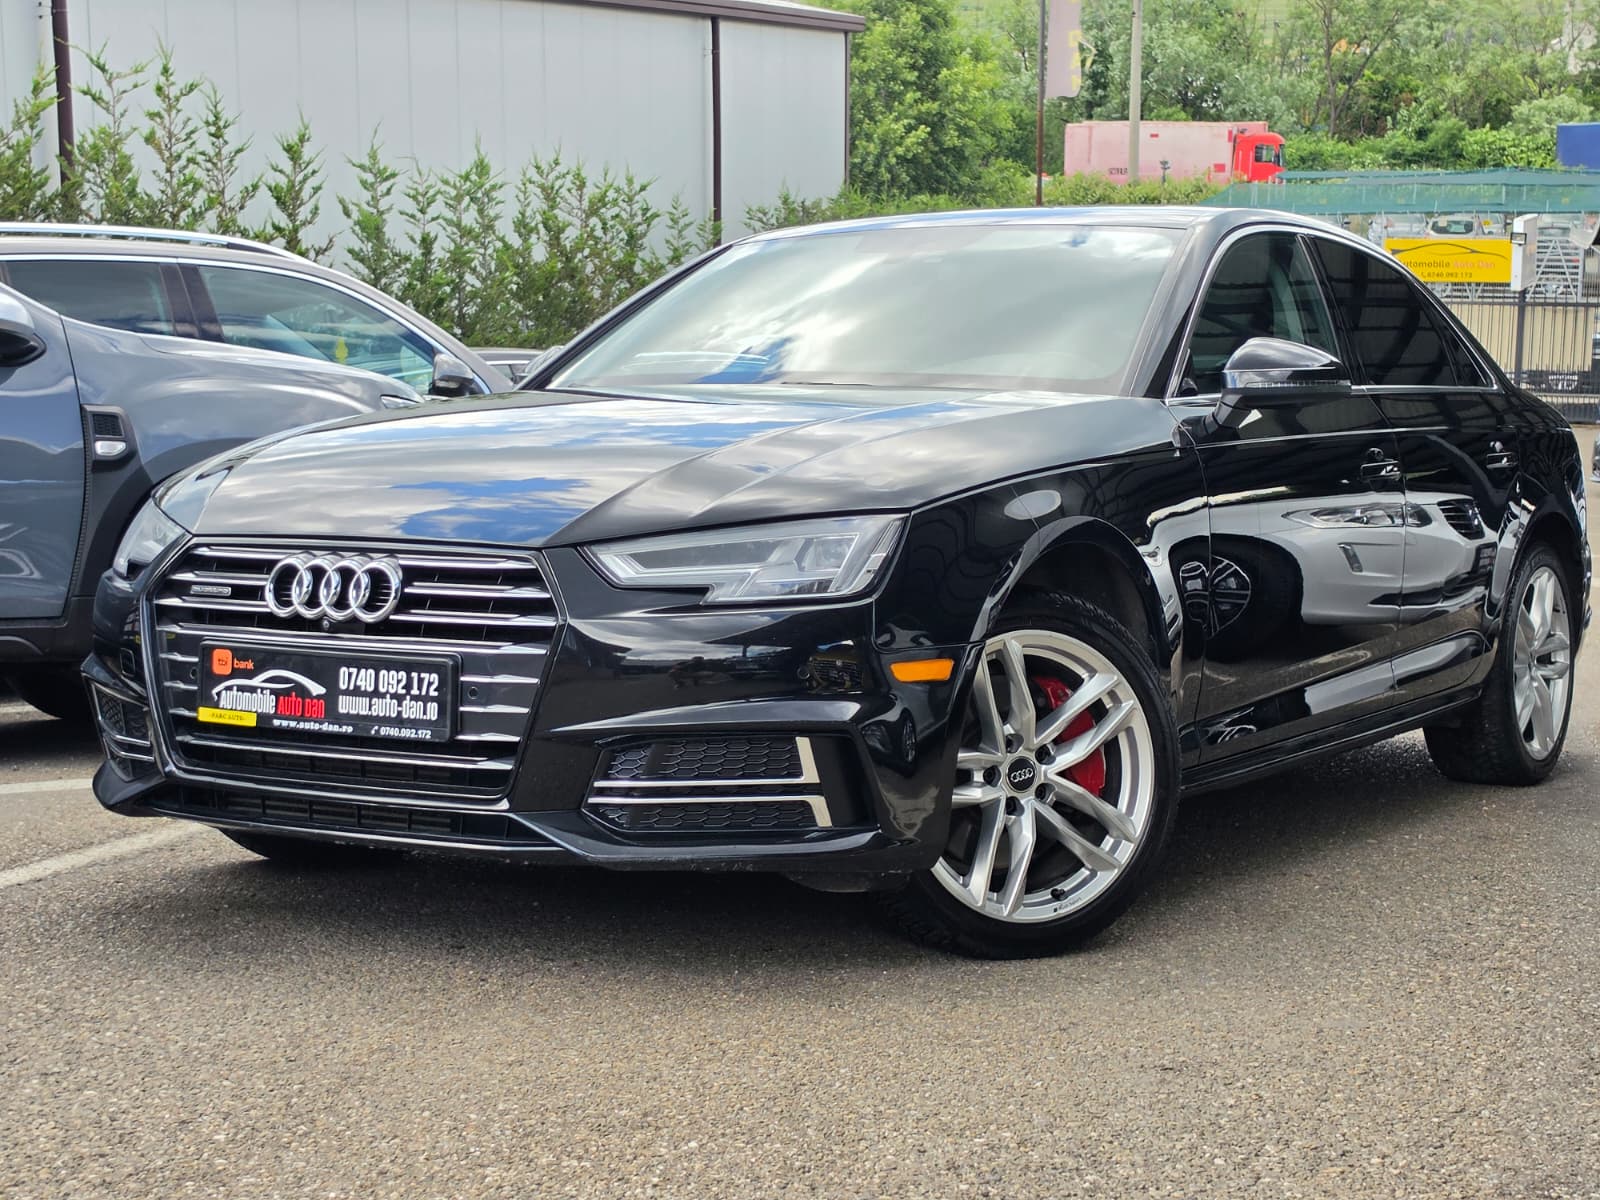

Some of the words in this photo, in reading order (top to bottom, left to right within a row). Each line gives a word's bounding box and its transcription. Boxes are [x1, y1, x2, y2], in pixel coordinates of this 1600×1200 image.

[1402, 259, 1450, 269] utomobile
[233, 657, 255, 670] bank
[339, 666, 375, 692] 0740
[378, 669, 407, 694] 092
[410, 671, 439, 696] 172
[219, 685, 276, 714] Automobile
[277, 691, 303, 716] Auto
[338, 693, 439, 721] www.auto-dan.ro
[272, 717, 353, 734] www.auto-dan.ro
[380, 726, 432, 739] 0740.092.172
